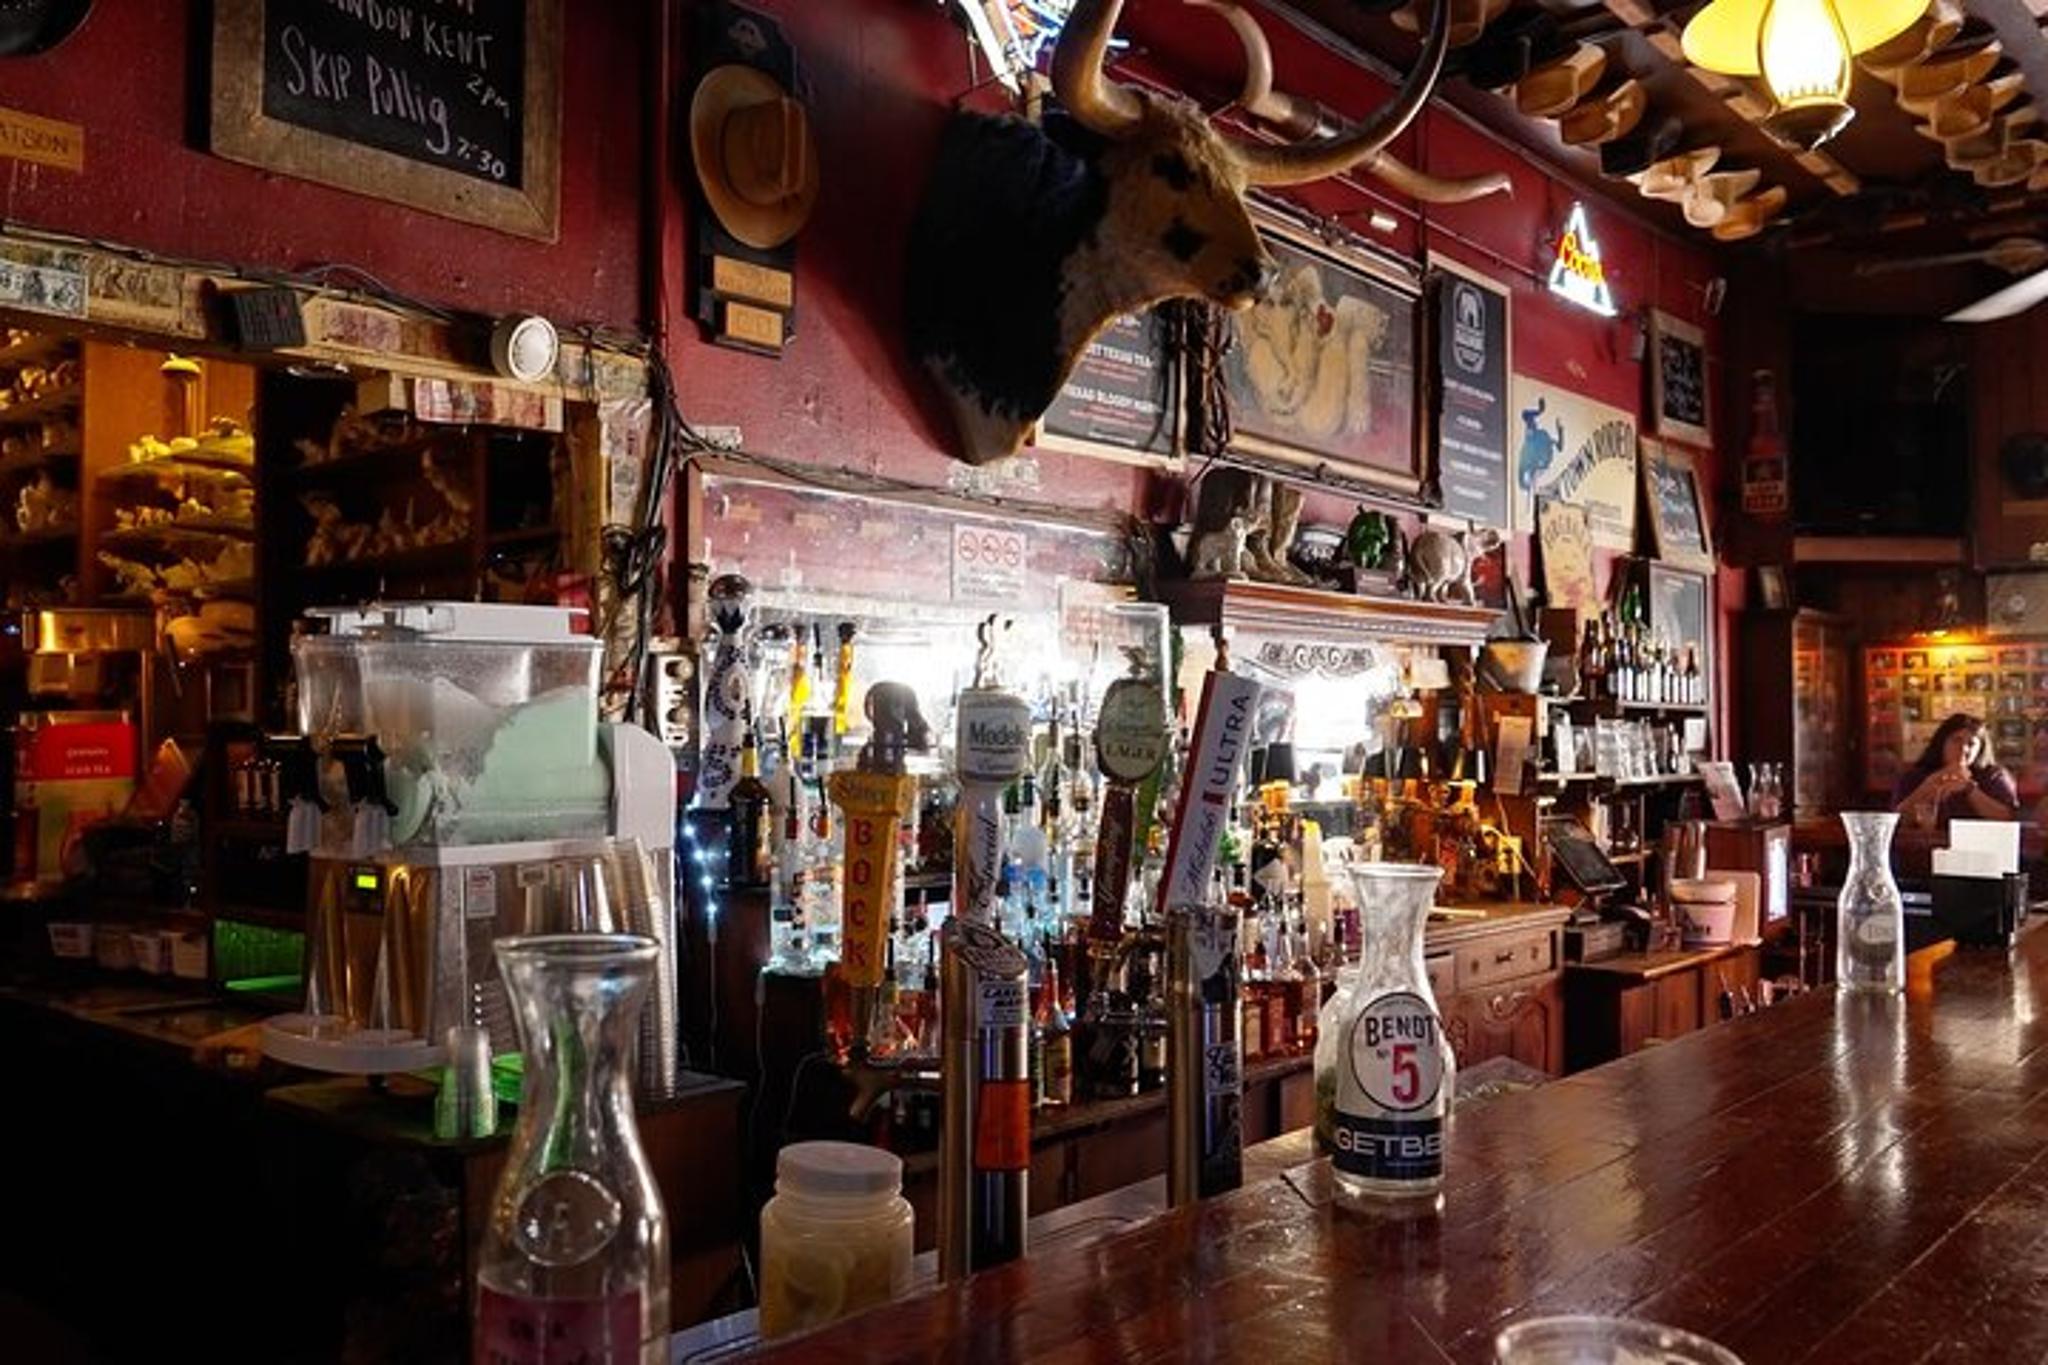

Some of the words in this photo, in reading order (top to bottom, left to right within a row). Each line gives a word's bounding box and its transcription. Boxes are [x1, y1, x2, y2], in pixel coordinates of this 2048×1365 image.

[281, 24, 351, 101] SKIP
[422, 14, 493, 69] KENT
[1211, 695, 1251, 787] ULTRA
[1391, 1043, 1421, 1103] 5
